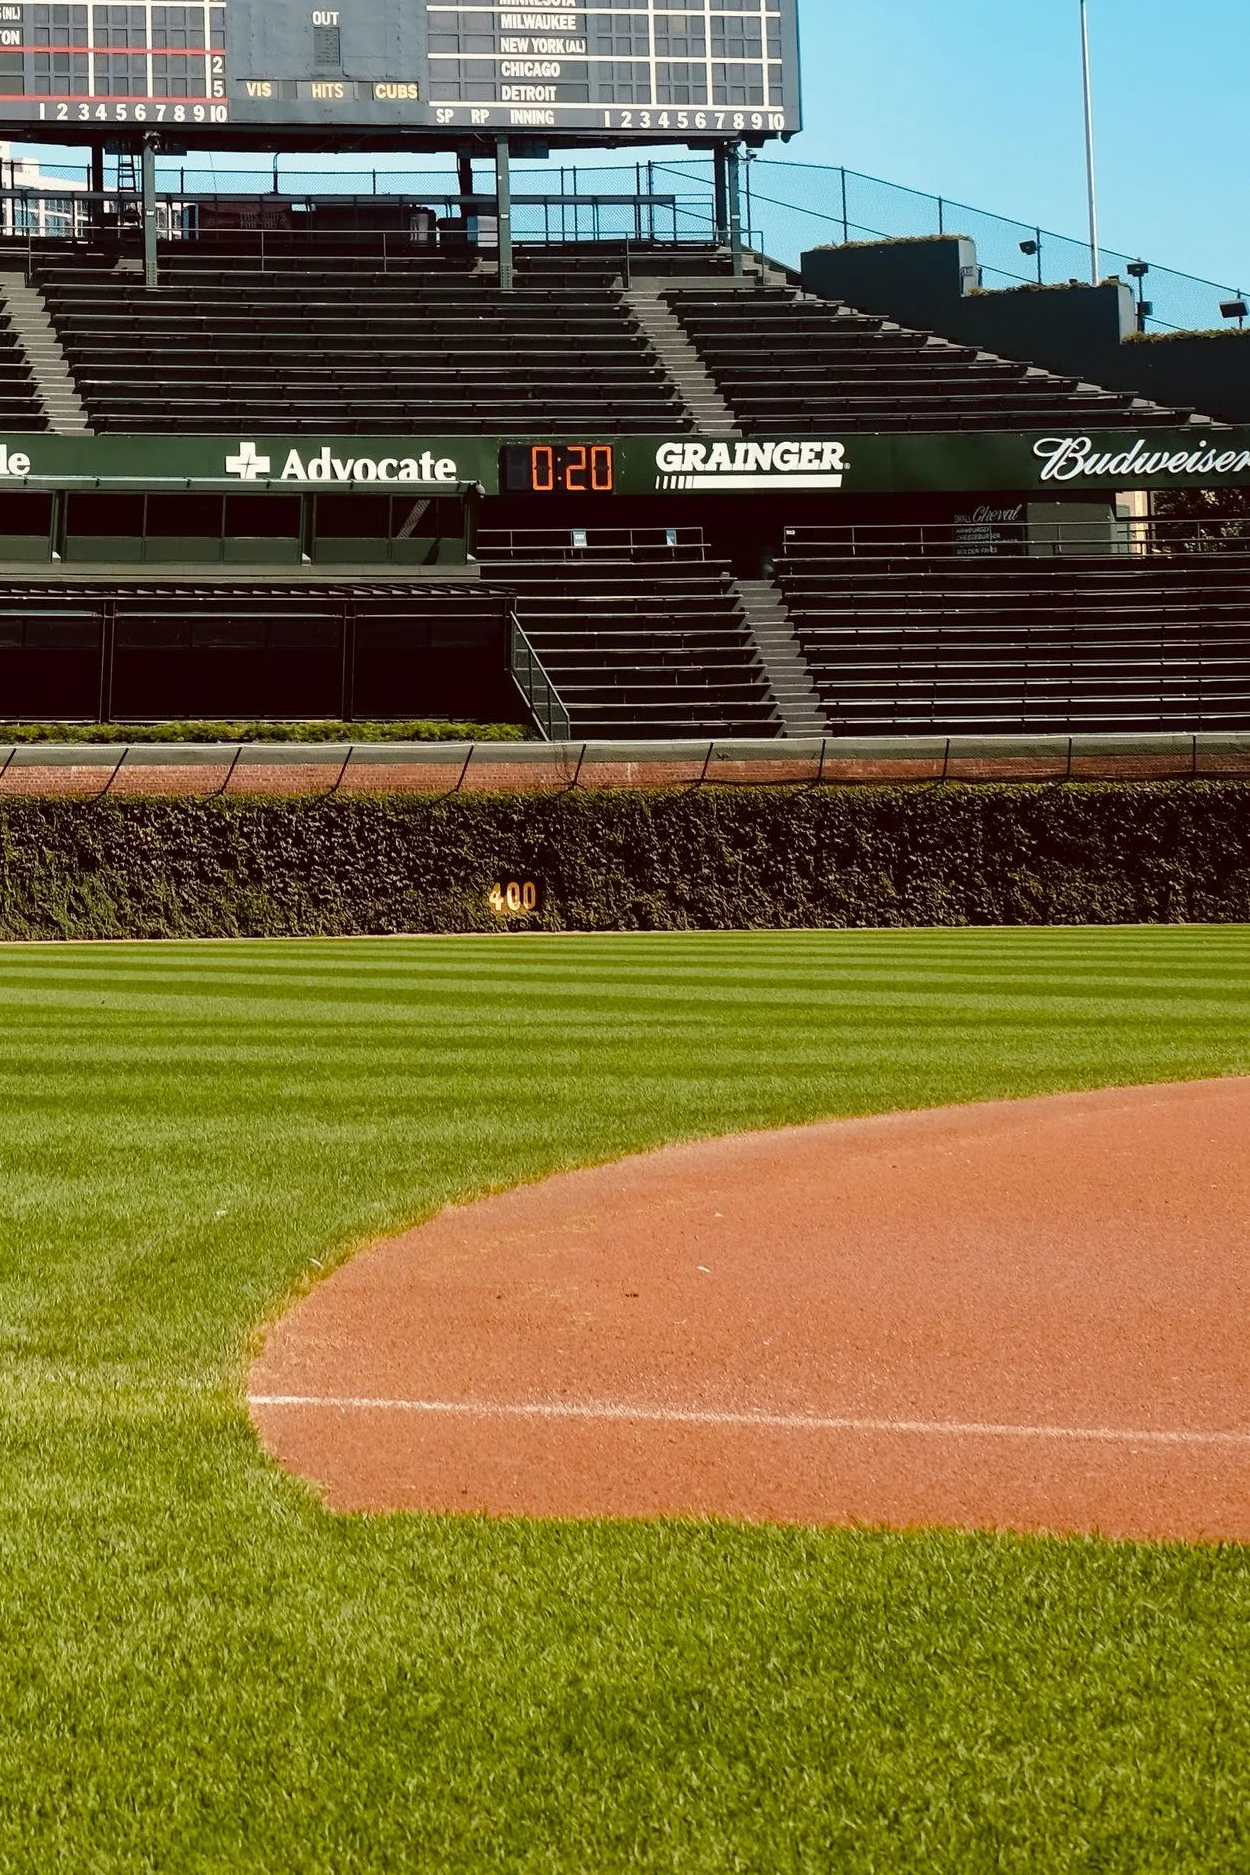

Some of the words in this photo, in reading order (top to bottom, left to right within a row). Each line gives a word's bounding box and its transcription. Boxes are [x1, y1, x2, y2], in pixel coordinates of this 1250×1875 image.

[313, 11, 339, 25] OUT
[501, 14, 576, 29] MILWAUKEE
[501, 38, 528, 52] NEW
[213, 56, 222, 73] 2
[502, 62, 560, 77] CHICAGO
[214, 81, 223, 97] 5
[246, 82, 271, 97] VIS
[312, 83, 343, 98] HITS
[376, 84, 417, 98] CUBS
[502, 86, 556, 101] DETROIT
[40, 104, 44, 119] 1
[57, 104, 68, 120] 2
[79, 104, 89, 120] 3
[96, 104, 107, 120] 4
[116, 104, 127, 120] 5
[135, 104, 146, 120] 6
[156, 105, 166, 121] 7
[174, 105, 185, 121] 8
[194, 105, 204, 122] 9
[211, 106, 227, 122] 10
[437, 109, 453, 123] SP
[471, 109, 489, 123] RP
[511, 110, 554, 124] INNING
[605, 111, 610, 127] 1
[621, 111, 632, 127] 2
[640, 112, 650, 128] 3
[658, 112, 670, 128] 4
[677, 112, 688, 128] 5
[695, 112, 706, 128] 6
[715, 113, 725, 129] 7
[733, 113, 744, 129] 8
[751, 113, 762, 129] 9
[768, 114, 784, 130] 10
[280, 447, 457, 480] Advocate
[532, 446, 613, 490] 0:20
[489, 881, 536, 911] 400
